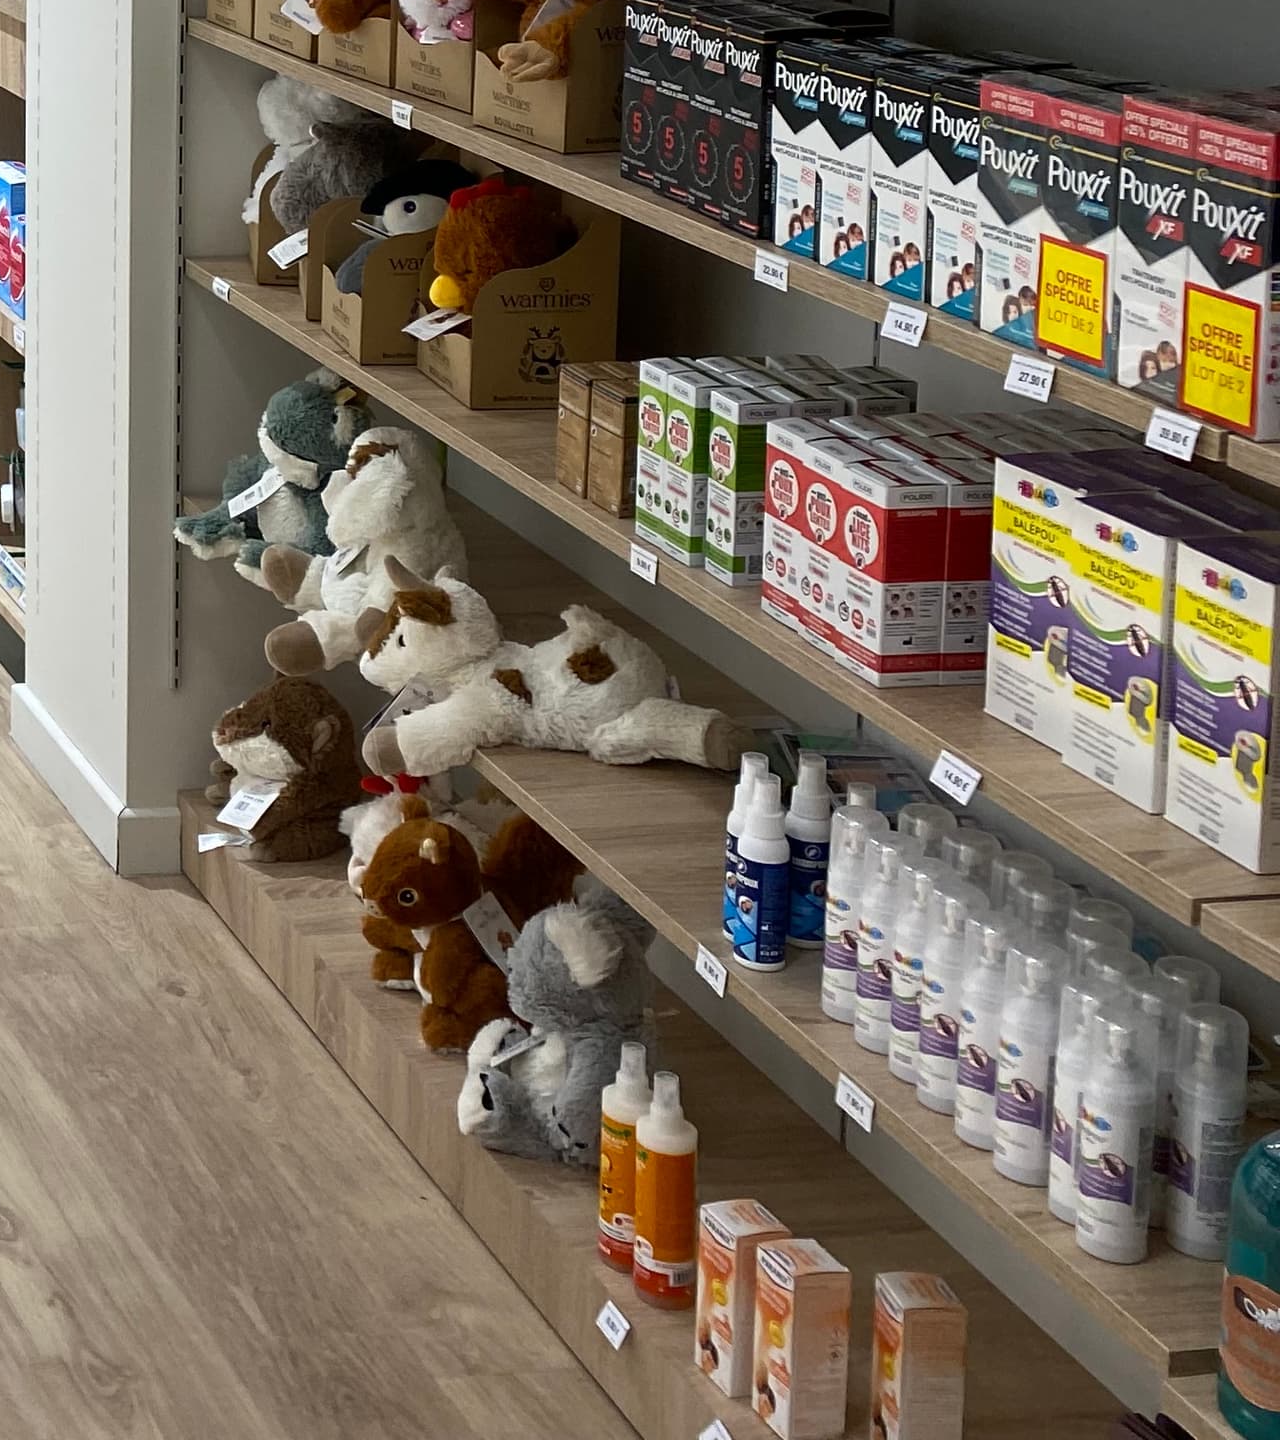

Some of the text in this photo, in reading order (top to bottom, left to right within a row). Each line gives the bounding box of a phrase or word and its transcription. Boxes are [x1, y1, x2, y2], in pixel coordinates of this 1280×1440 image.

[625, 5, 659, 37] Pouxit
[658, 18, 692, 51] Pouxit
[691, 30, 724, 62] Pouxit
[726, 40, 760, 76] Pouxit
[775, 62, 820, 99] Pouxit
[820, 75, 868, 114] Pouxit
[632, 112, 643, 133] 5
[875, 90, 925, 130] Pouxit
[1125, 110, 1149, 125] OFFRE
[664, 126, 675, 149] 5
[1148, 130, 1190, 150] OFFERTS
[1198, 128, 1225, 145] OFFRE
[698, 142, 708, 165] 5
[734, 156, 744, 180] 5
[981, 135, 1040, 182] Pouxit
[1224, 149, 1269, 171] OFFERTS
[1048, 154, 1112, 203] Pouxit
[1119, 166, 1188, 219] Pouxit
[1192, 187, 1267, 242] Pouxit
[1055, 268, 1093, 294] OFFRE
[500, 288, 592, 309] warmies
[1047, 306, 1095, 336] LOT DE 2
[1200, 323, 1244, 350] OFFRE
[1191, 362, 1245, 394] LOT DE 2
[942, 768, 963, 789] 14.90
